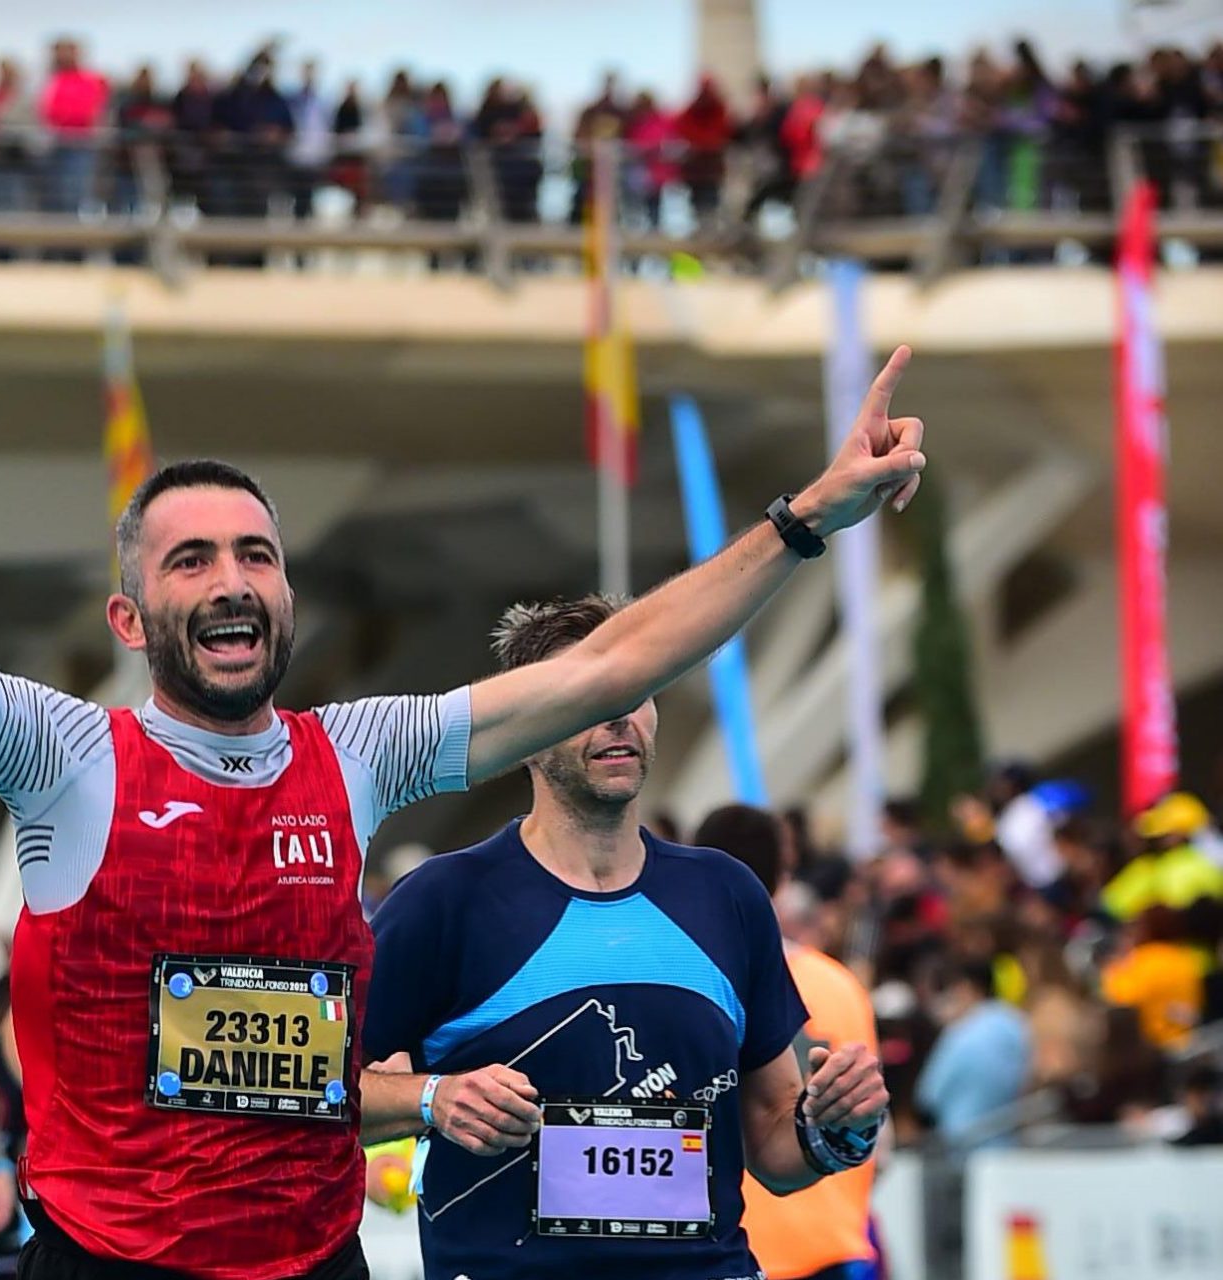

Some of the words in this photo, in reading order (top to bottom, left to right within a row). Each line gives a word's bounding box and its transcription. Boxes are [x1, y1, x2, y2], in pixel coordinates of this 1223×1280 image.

[271, 814, 296, 827] ALTO
[298, 814, 327, 827] LAZIO
[220, 966, 263, 980] VALENCIA
[205, 1010, 310, 1048] 23313
[179, 1047, 330, 1092] DANIELE
[583, 1146, 674, 1177] 16152
